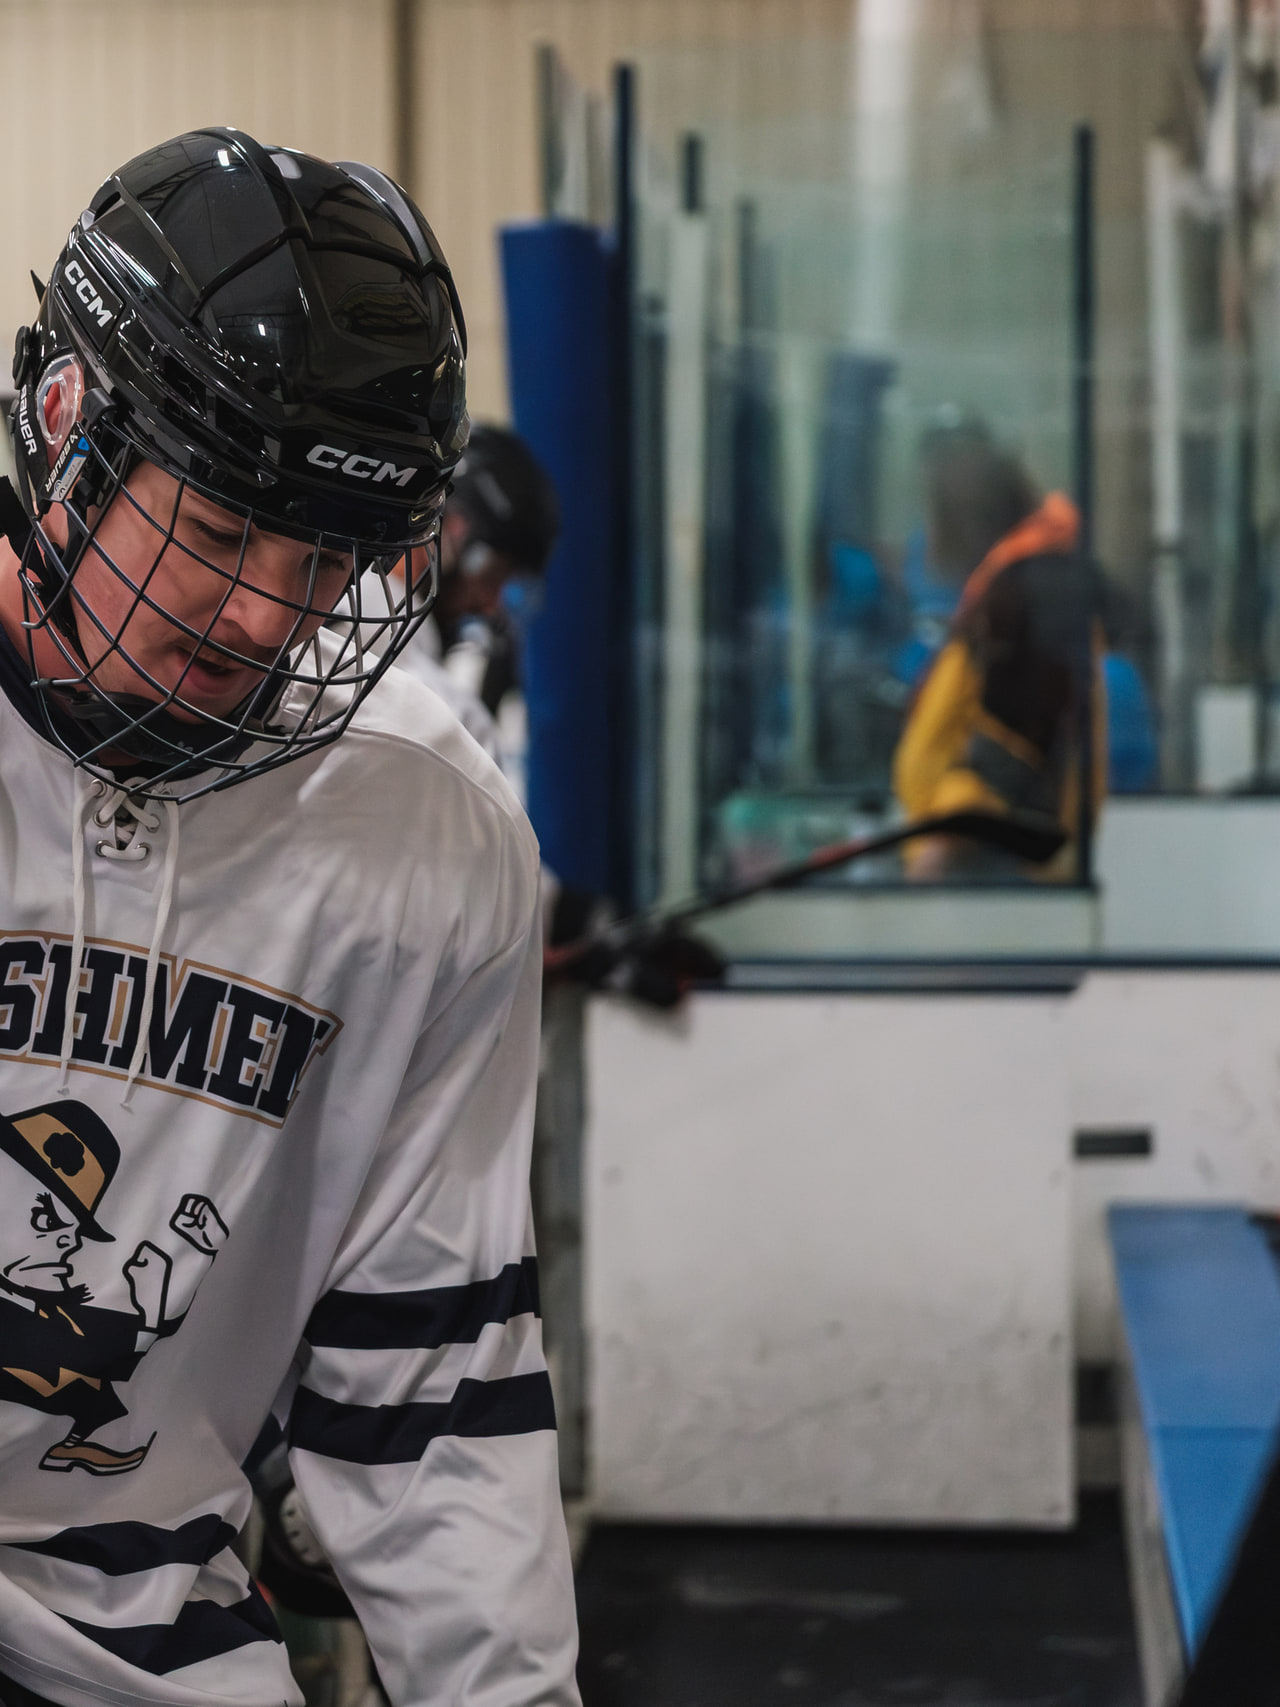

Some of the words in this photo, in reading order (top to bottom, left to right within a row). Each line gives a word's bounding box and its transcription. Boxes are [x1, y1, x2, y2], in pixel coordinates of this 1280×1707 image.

[64, 260, 113, 328] CCM
[45, 440, 72, 493] BAUER
[306, 444, 418, 487] CCM
